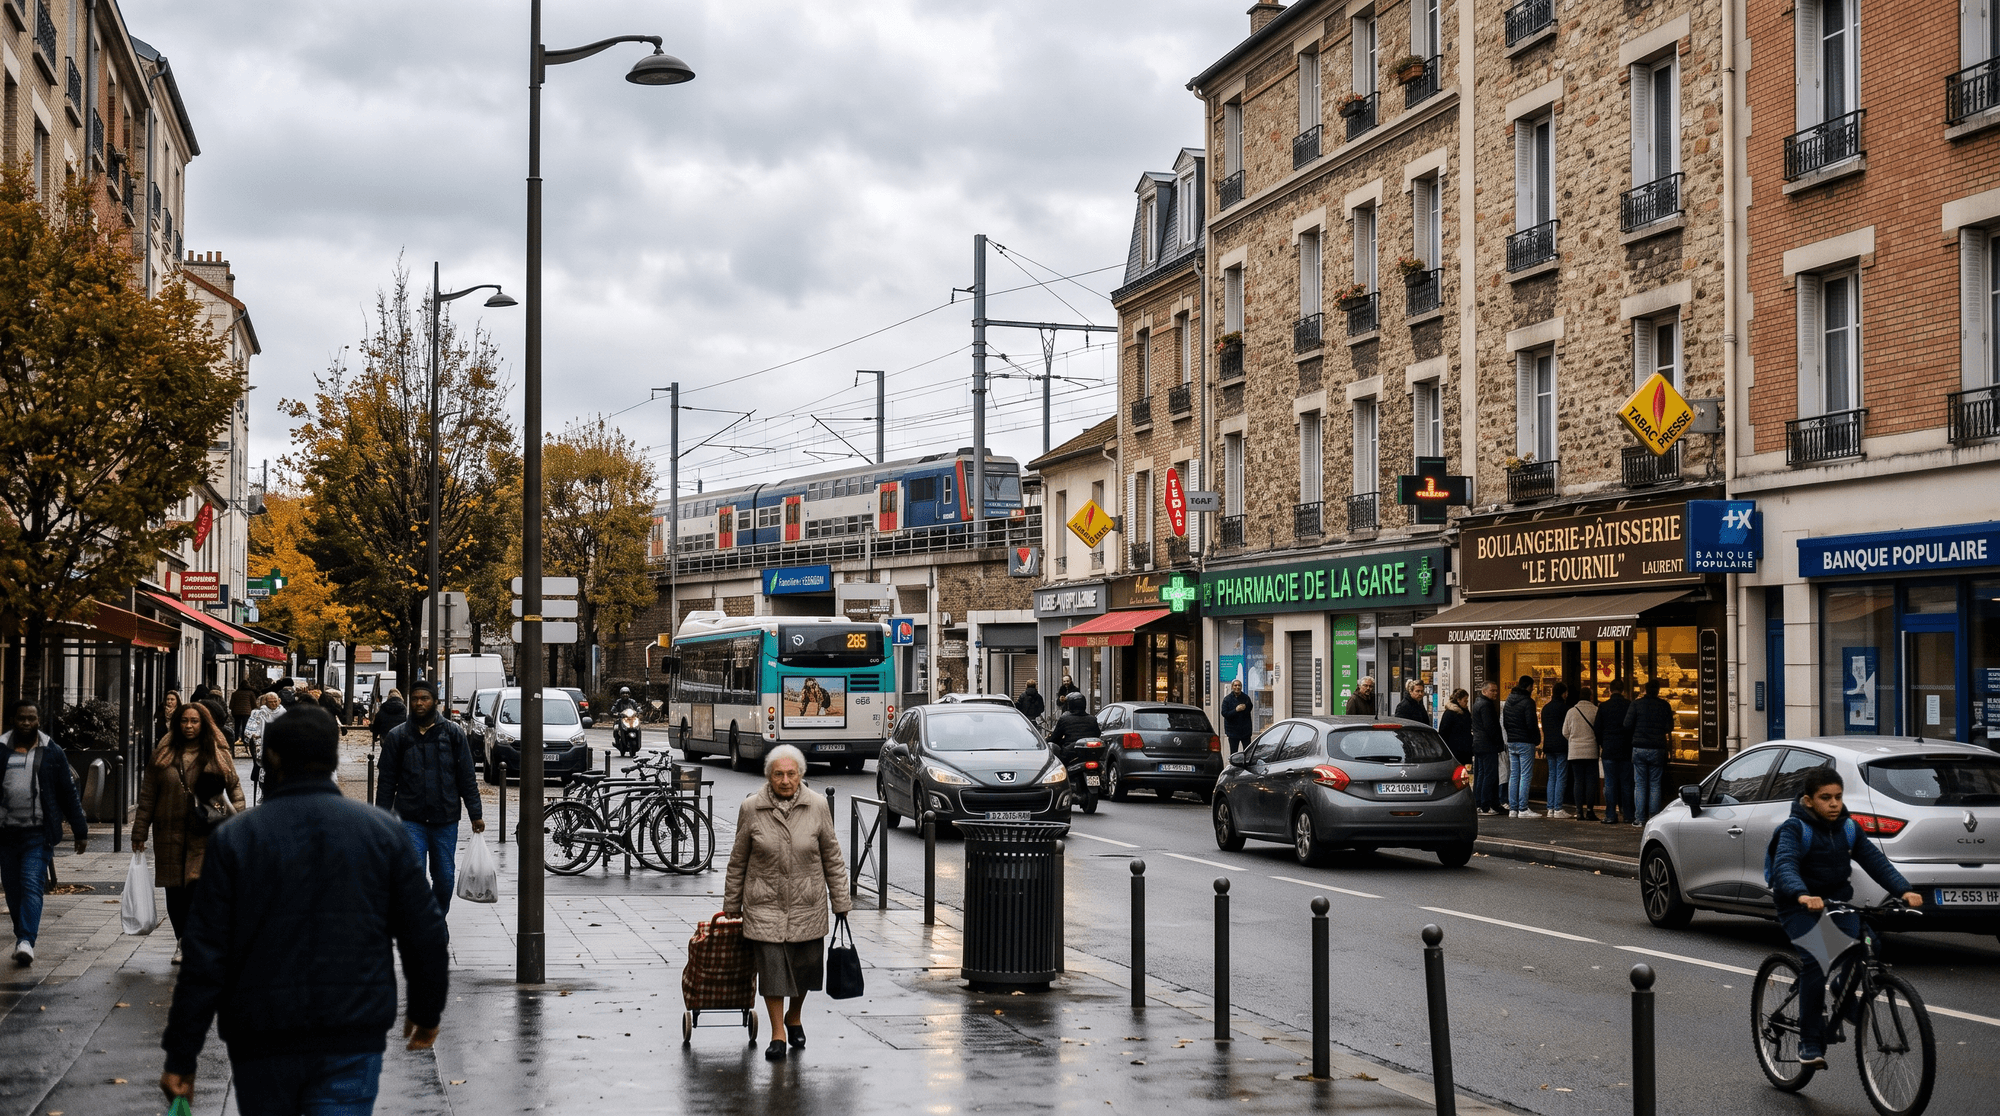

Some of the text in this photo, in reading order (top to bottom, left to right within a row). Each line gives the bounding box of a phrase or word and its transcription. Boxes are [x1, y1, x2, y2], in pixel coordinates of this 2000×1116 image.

[1628, 406, 1658, 441] TABAC
[1657, 410, 1691, 449] PRESSE
[1477, 515, 1681, 559] BOULANGERIE-PÂTISSERIE
[1642, 558, 1684, 575] LAURENT
[1696, 551, 1753, 560] BANQUE
[1696, 560, 1753, 568] POPULAIRE
[1823, 539, 1987, 571] BANQUE POPULAIRE
[1217, 562, 1405, 605] PHARMACIE DE LA GARE
[846, 633, 867, 648] 285
[1597, 625, 1632, 637] LAURENT
